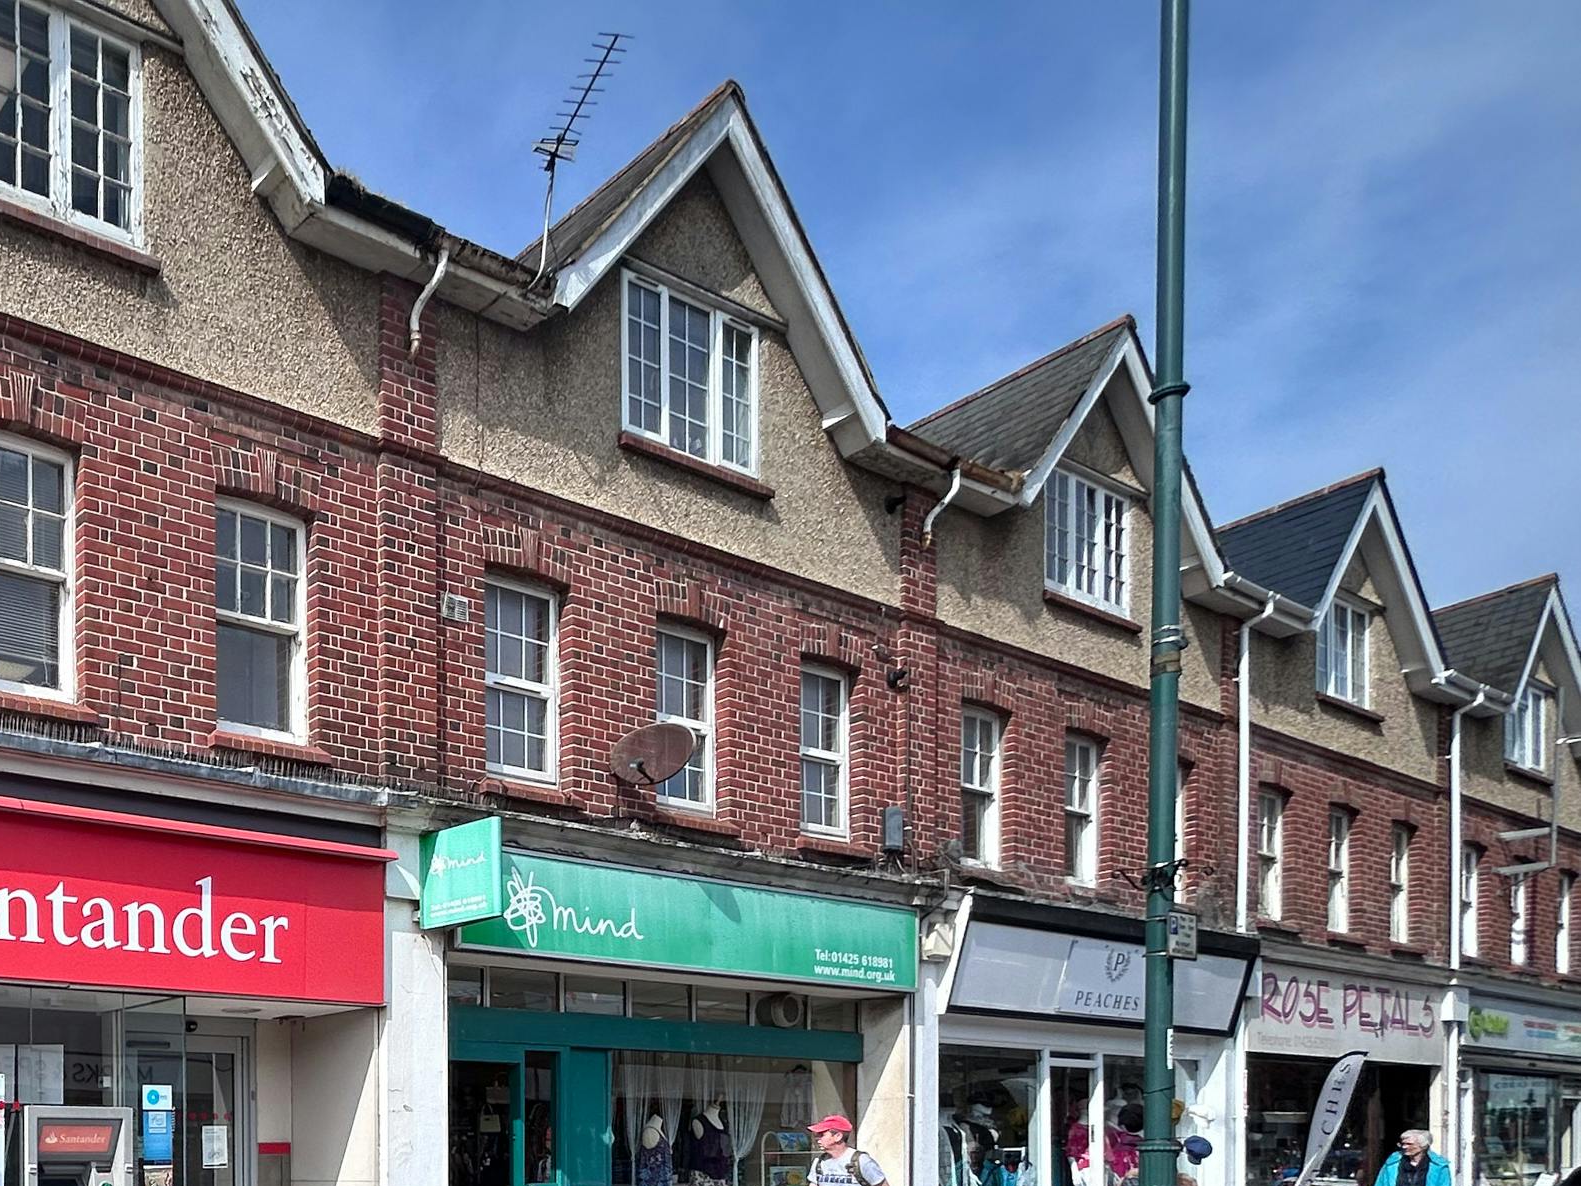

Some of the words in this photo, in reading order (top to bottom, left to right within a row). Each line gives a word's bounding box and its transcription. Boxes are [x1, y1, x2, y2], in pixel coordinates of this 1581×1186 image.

[447, 852, 485, 869] mind
[551, 906, 644, 940] mind
[861, 954, 894, 969] 618981
[1113, 952, 1126, 972] P
[813, 964, 896, 983] www.mind.org.uk
[1074, 990, 1140, 1011] PEACHES
[1261, 972, 1334, 1030] ROSE
[1342, 983, 1436, 1040] PETALS
[58, 1133, 107, 1145] Santander
